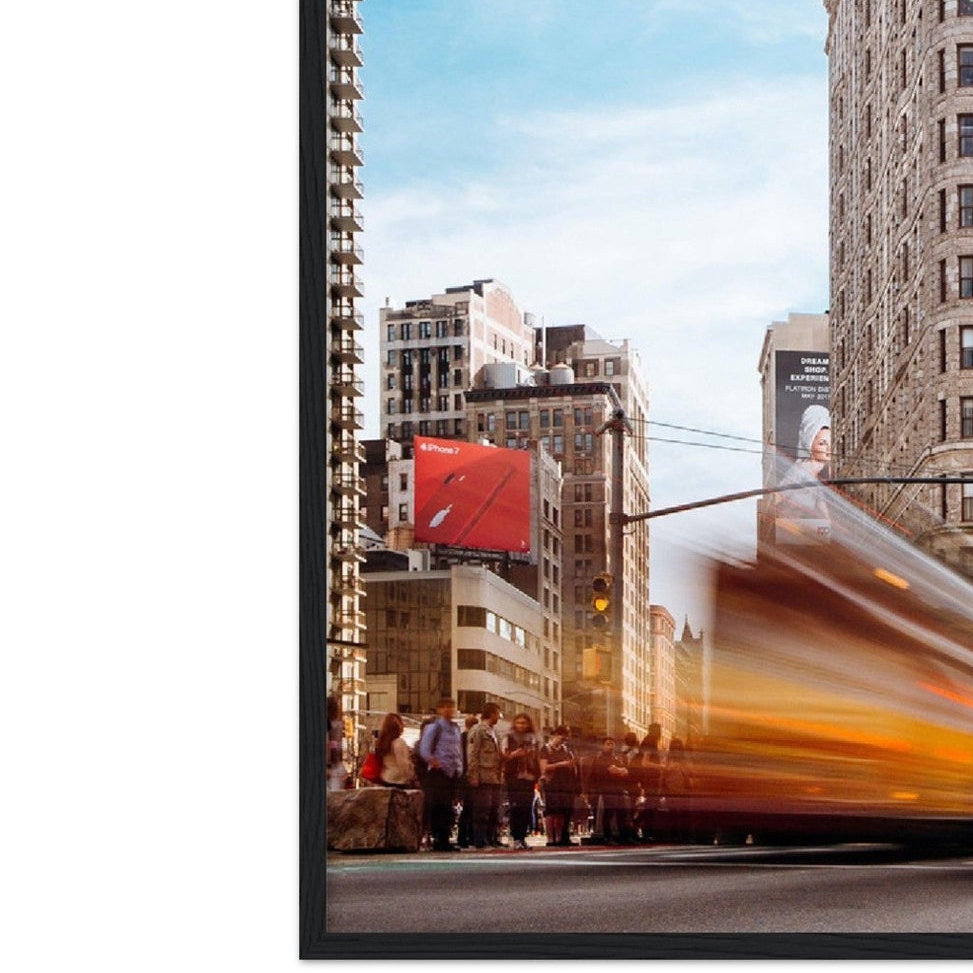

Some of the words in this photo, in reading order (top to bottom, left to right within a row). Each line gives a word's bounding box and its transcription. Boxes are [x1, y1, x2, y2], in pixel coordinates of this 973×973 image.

[790, 374, 829, 382] EXPERIEN
[427, 443, 454, 455] iPhone
[454, 446, 461, 455] 7
